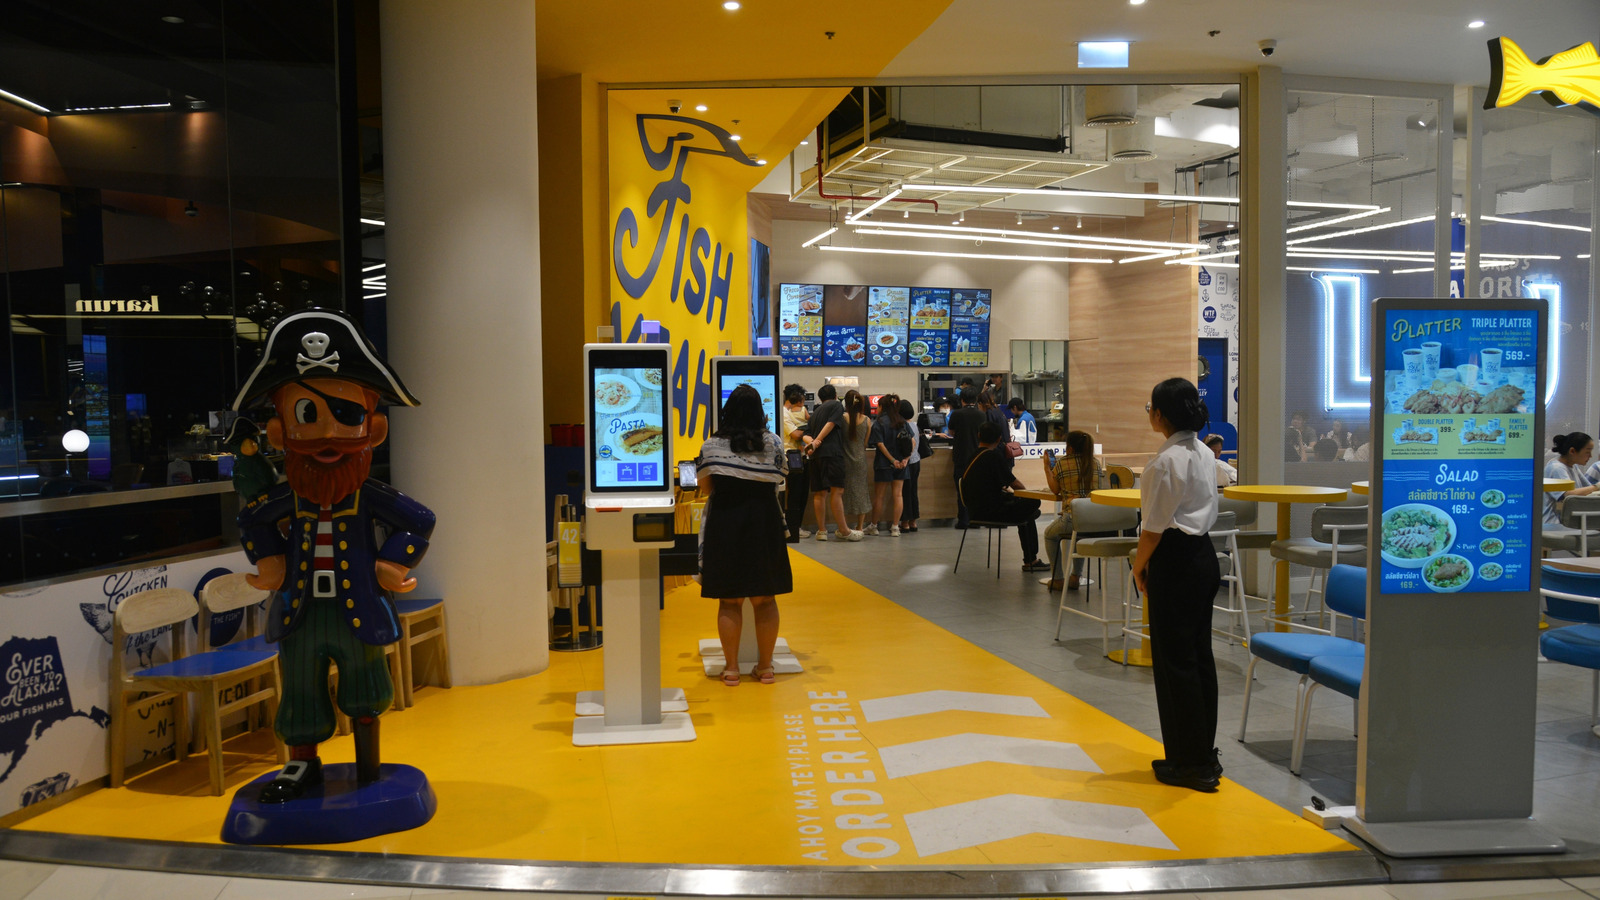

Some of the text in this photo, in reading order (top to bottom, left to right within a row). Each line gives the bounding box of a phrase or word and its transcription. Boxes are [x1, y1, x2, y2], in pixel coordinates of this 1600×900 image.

[613, 145, 745, 331] FISH
[1391, 317, 1462, 342] PLATTER
[1471, 318, 1532, 328] TRIPLE PLATTER
[1505, 351, 1530, 361] 569.-
[609, 418, 646, 434] PASTA
[1025, 448, 1043, 456] ICK
[1435, 463, 1479, 485] SALAD
[1451, 504, 1475, 514] 169.-
[562, 528, 578, 544] 42
[1400, 581, 1419, 589] 169.-
[134, 632, 151, 647] the
[5, 652, 54, 685] EVER
[19, 671, 55, 688] BEEN TO
[0, 673, 63, 707] ALASKA?
[0, 698, 65, 723] OUR FISH HAS
[807, 690, 901, 859] ORDER HERE
[784, 713, 829, 861] AHOY MATEY! PLEASE
